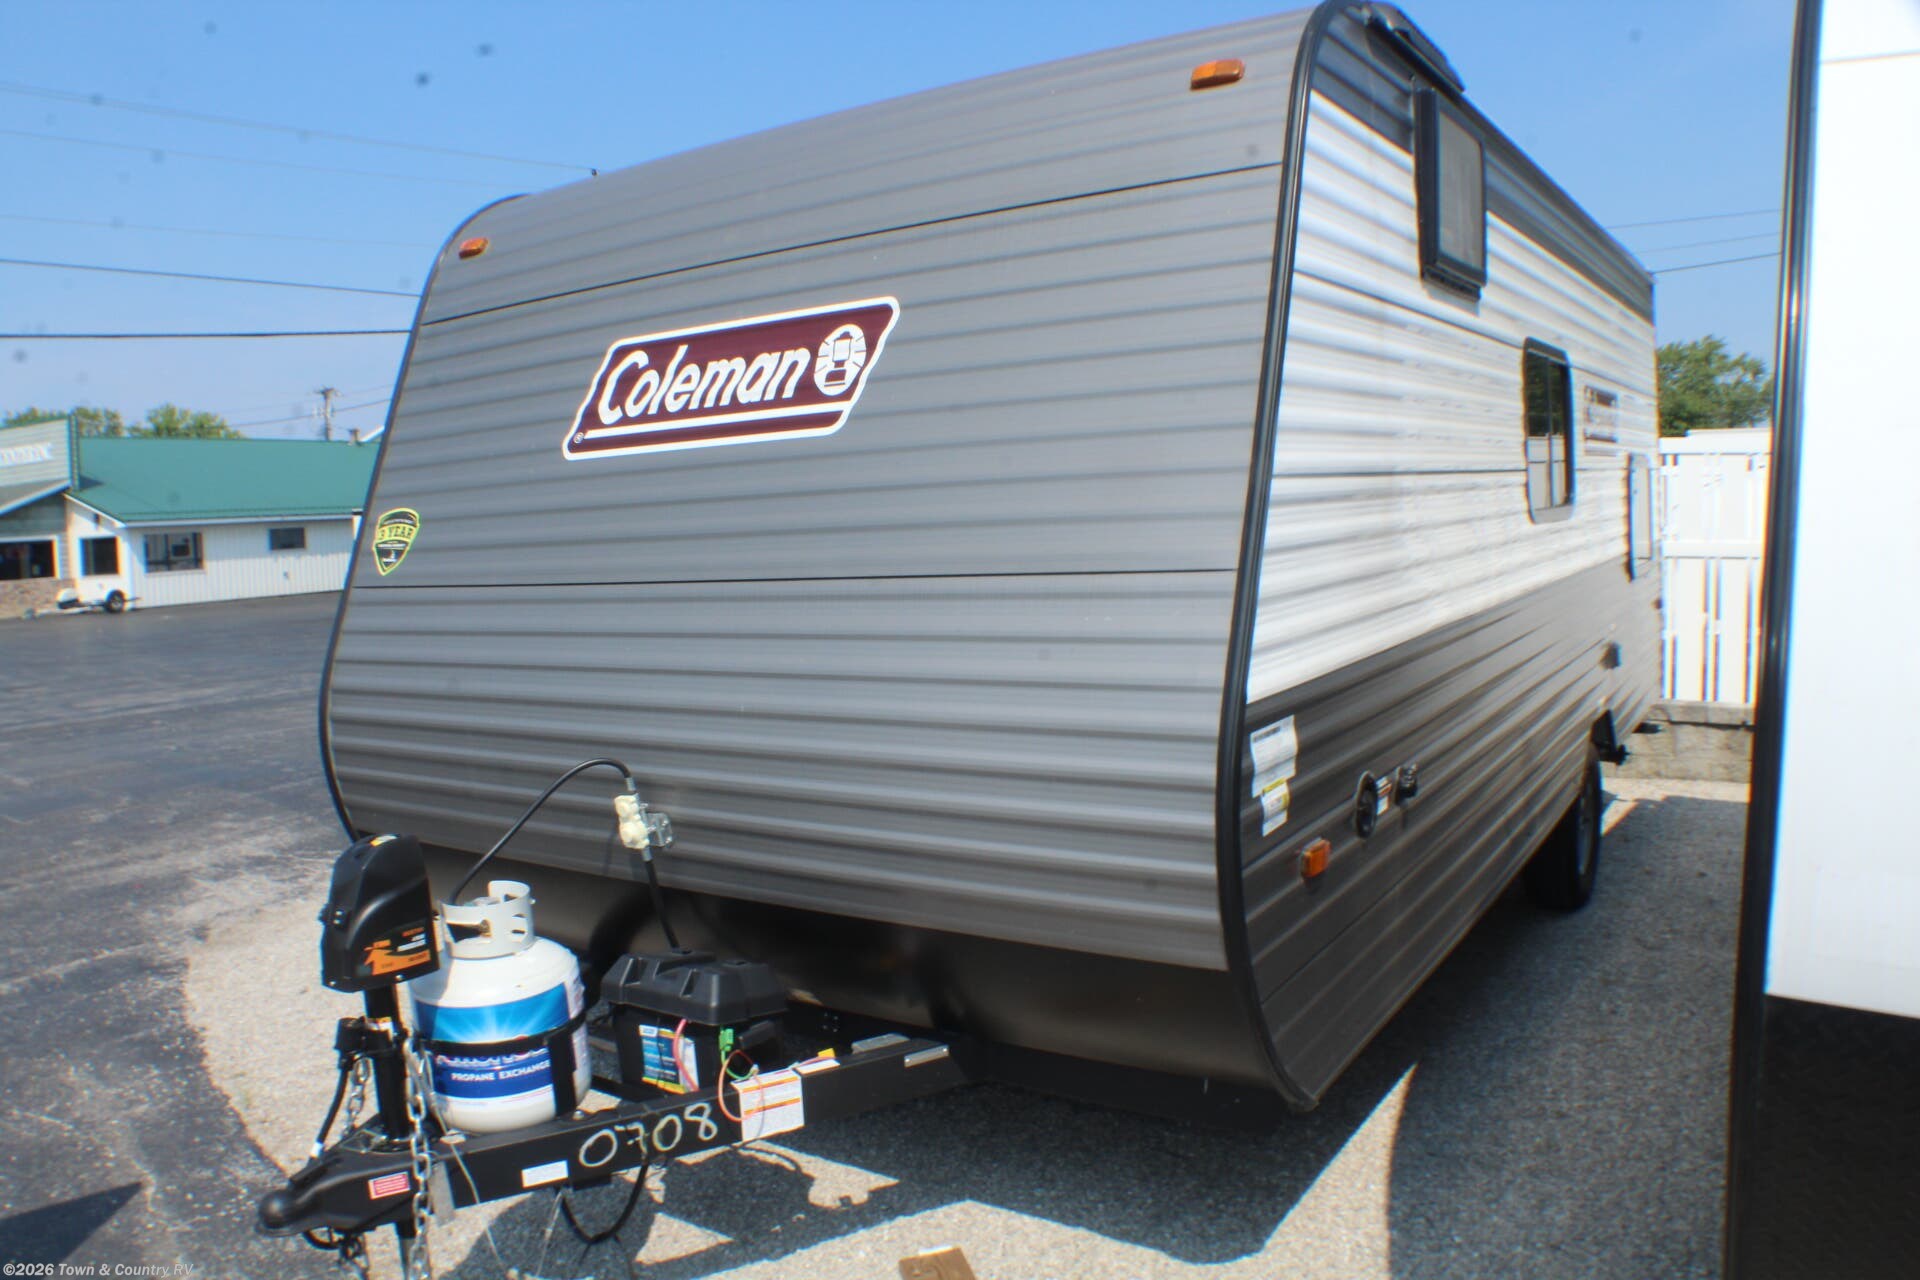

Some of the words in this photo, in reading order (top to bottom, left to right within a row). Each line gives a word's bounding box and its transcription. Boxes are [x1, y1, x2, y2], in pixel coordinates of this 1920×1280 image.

[598, 344, 811, 425] Coleman
[451, 1071, 496, 1082] PROPANE
[498, 1058, 551, 1080] EXCHANGE
[579, 1102, 718, 1167] 0708
